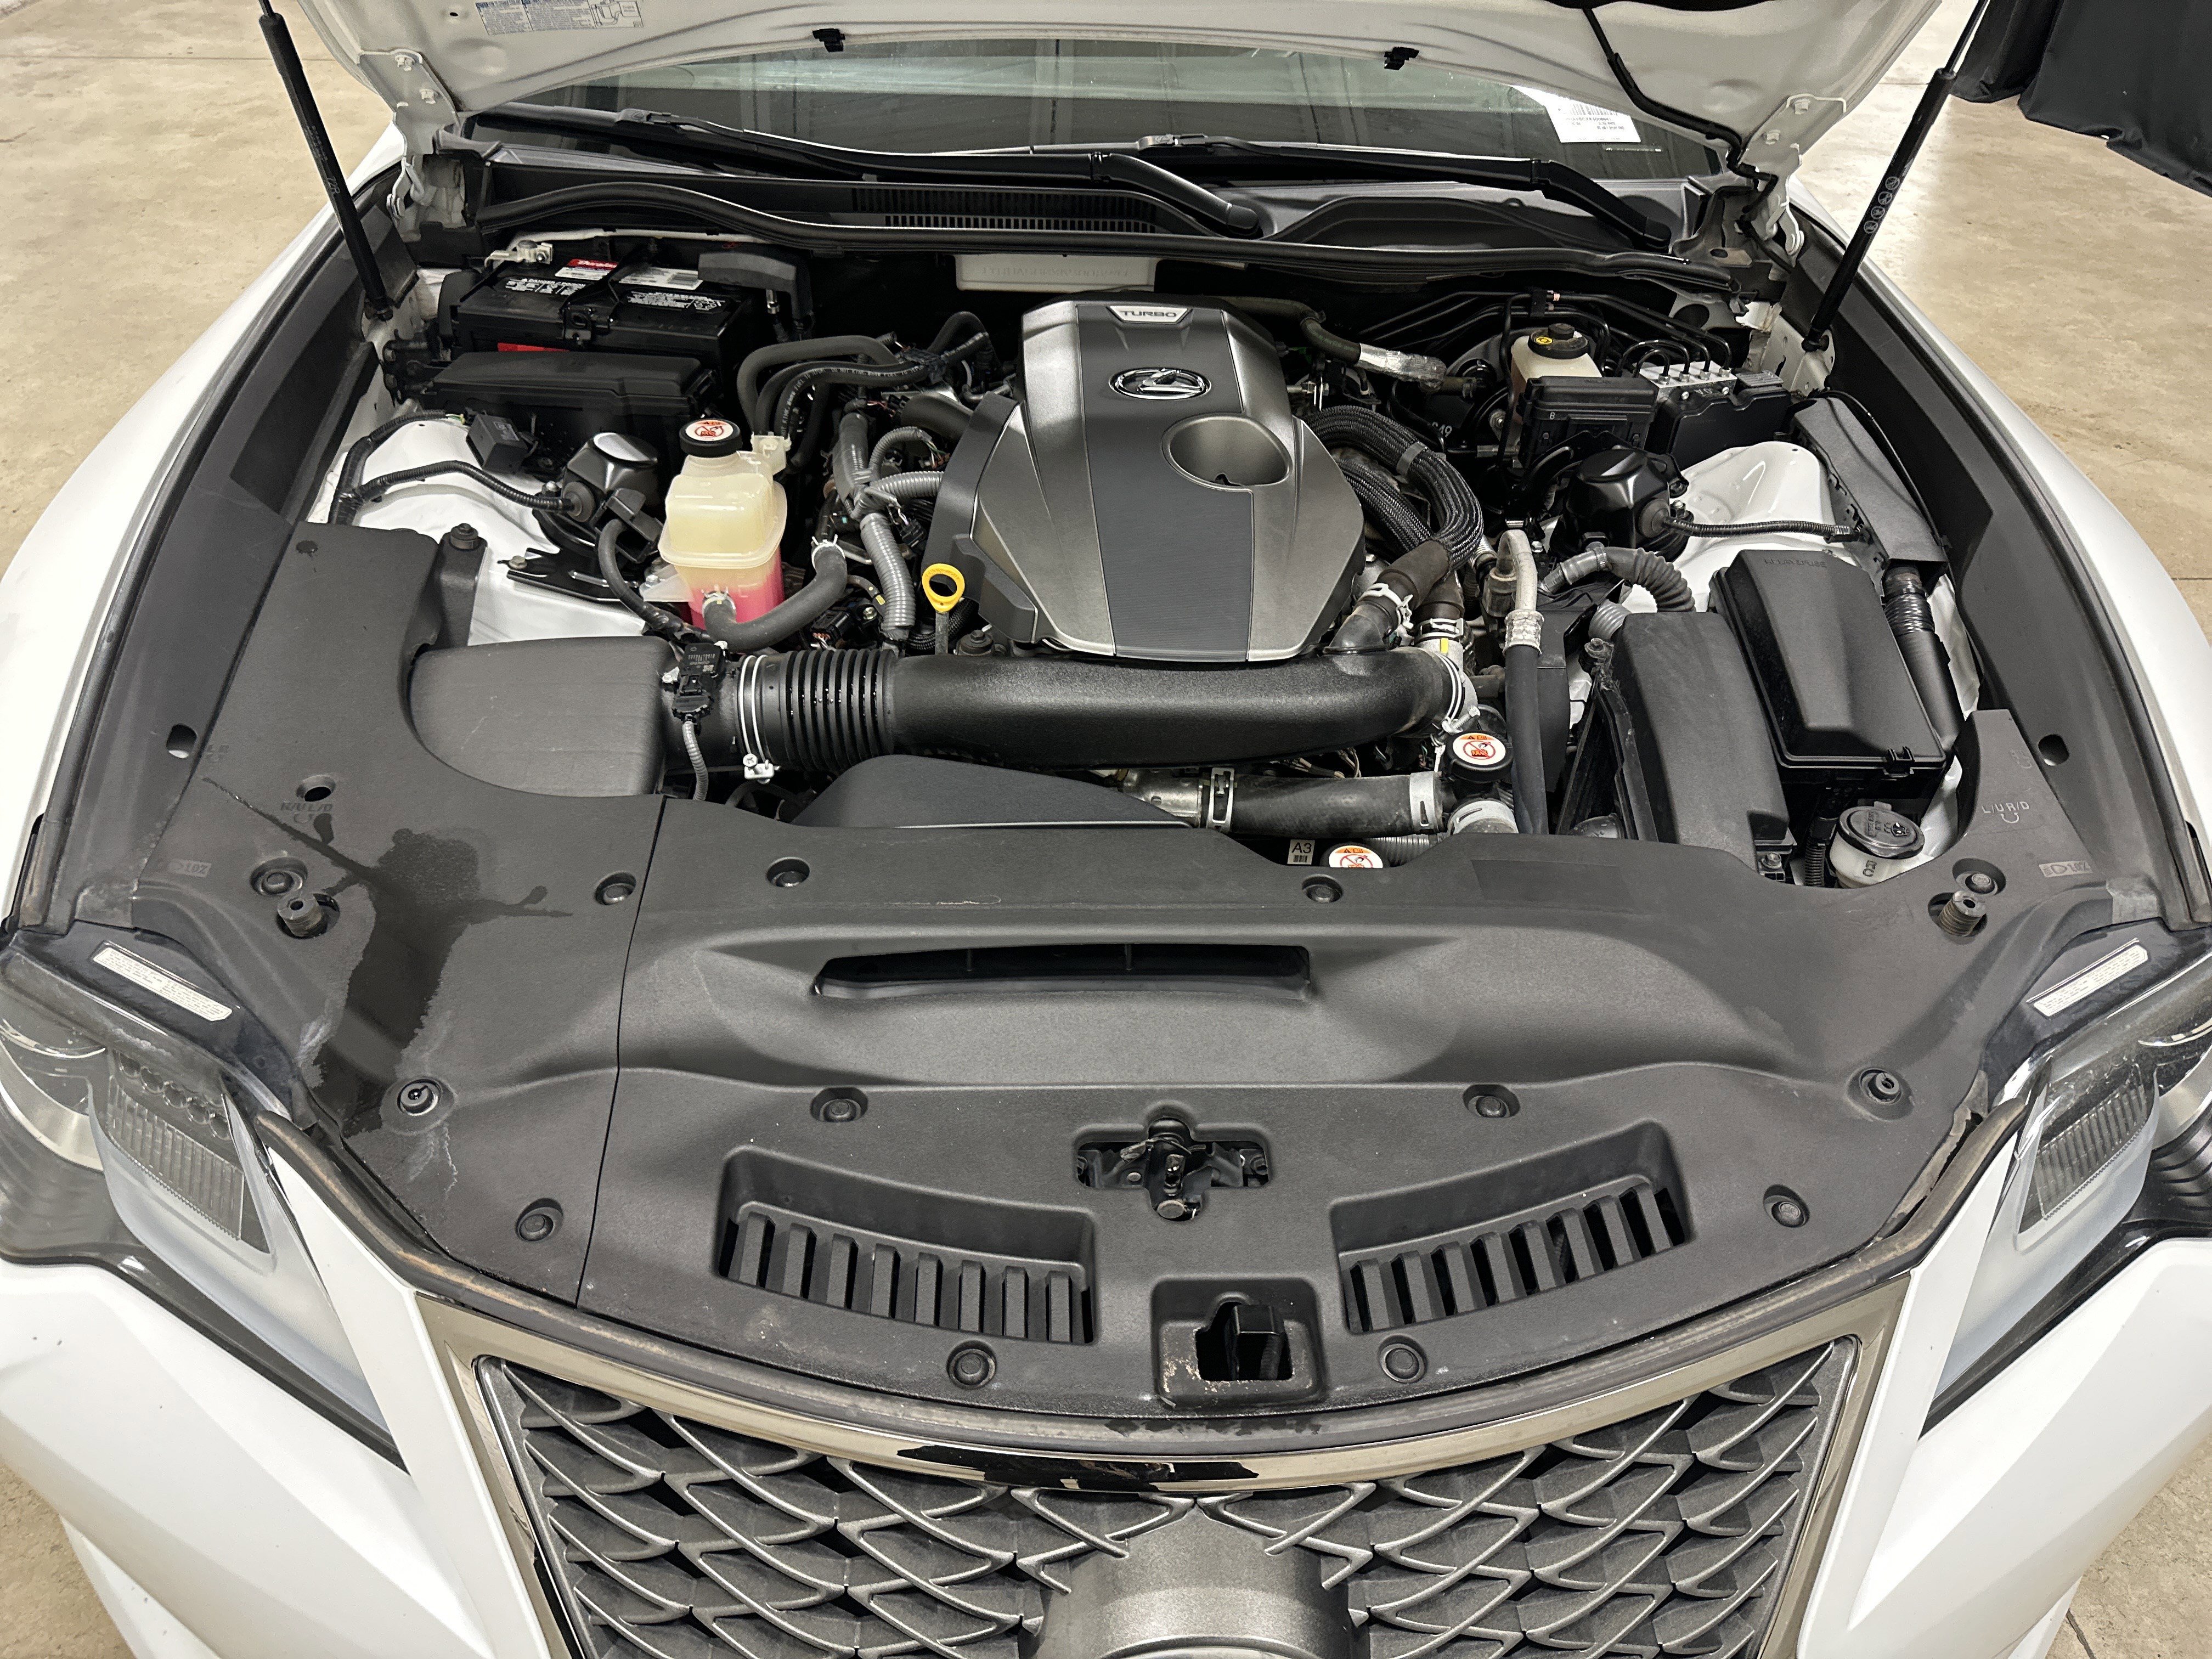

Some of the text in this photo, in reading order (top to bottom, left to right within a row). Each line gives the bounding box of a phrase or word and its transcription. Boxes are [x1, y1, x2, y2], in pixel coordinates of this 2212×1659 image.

[1549, 411, 1555, 420] B
[1982, 800, 2029, 814] L/U R/D
[1291, 842, 1312, 854] A3
